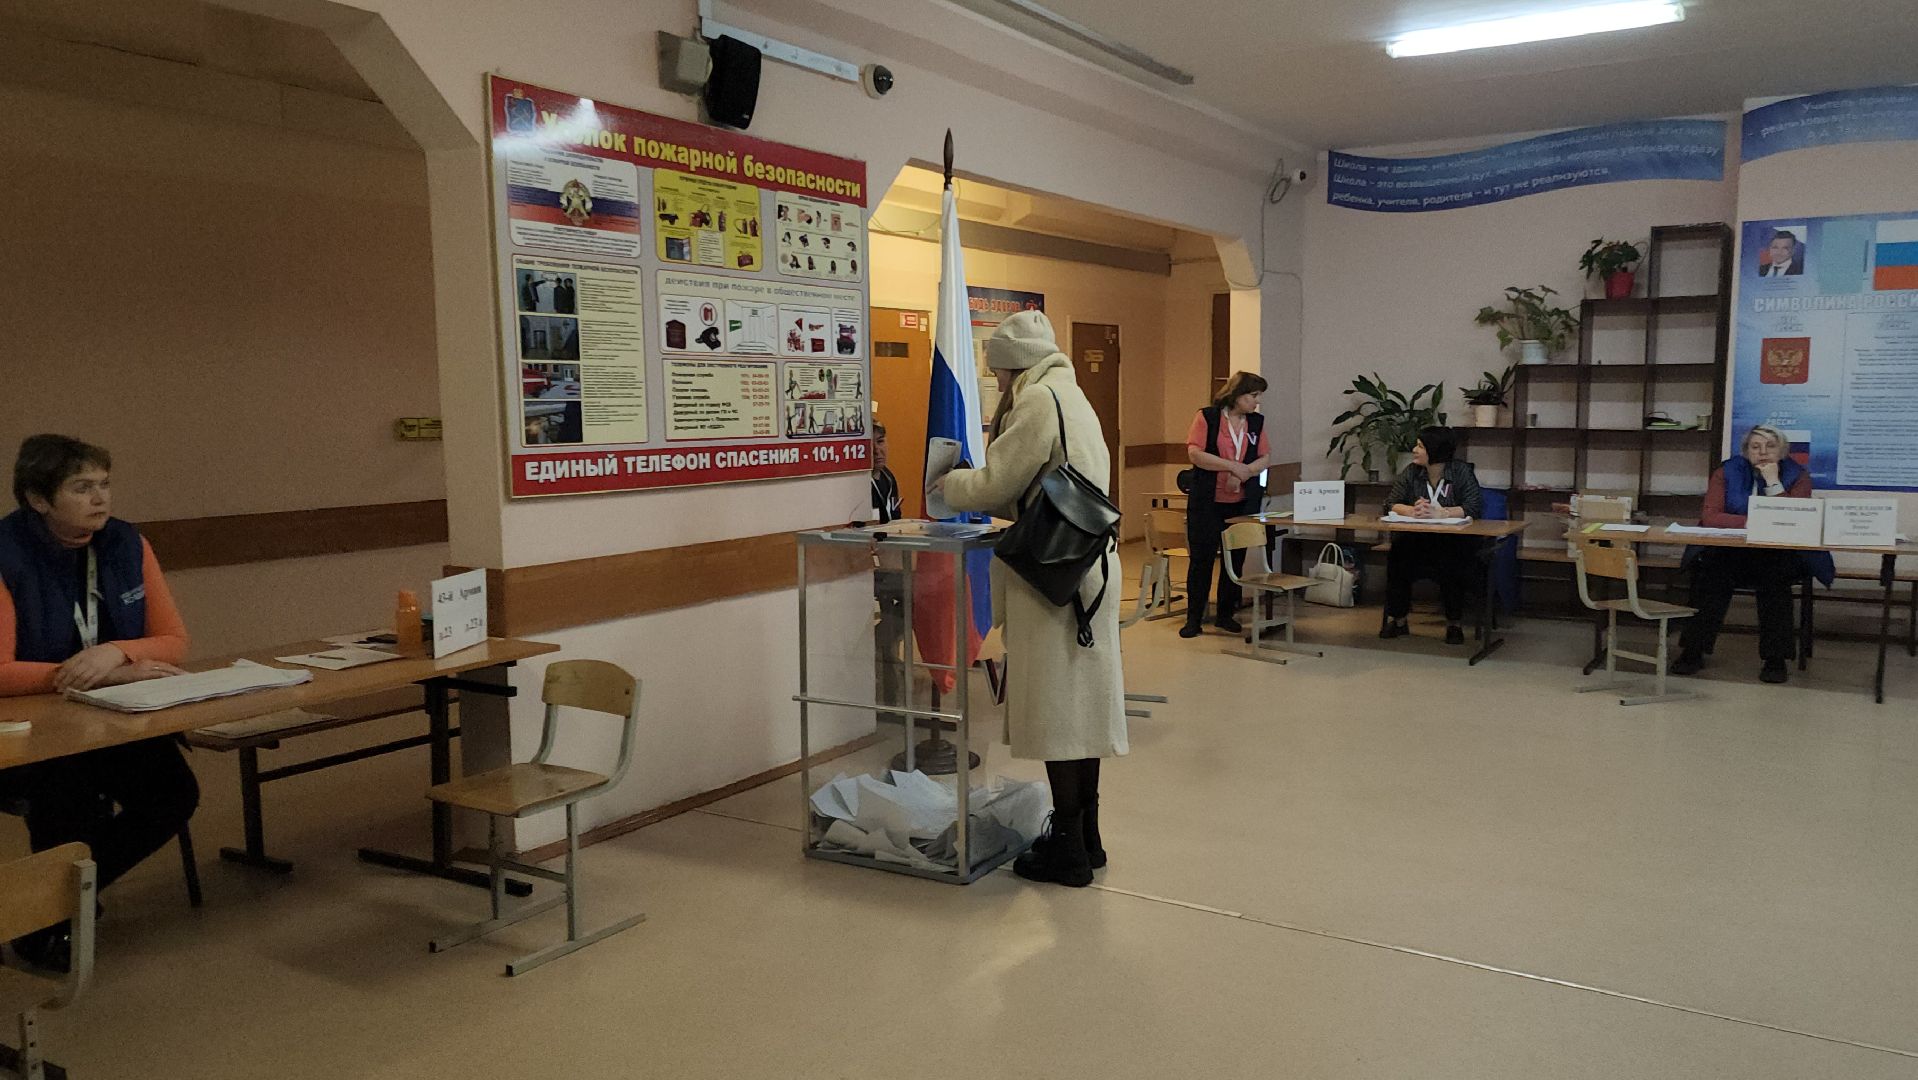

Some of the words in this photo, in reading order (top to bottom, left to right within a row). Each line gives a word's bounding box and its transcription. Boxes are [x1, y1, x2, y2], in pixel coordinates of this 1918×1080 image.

[540, 110, 627, 153] Улок
[634, 136, 738, 174] пожарной
[743, 155, 861, 198] безопасности
[1494, 184, 1510, 197] тут
[711, 281, 729, 293] при
[731, 283, 765, 295] пожаре
[1754, 295, 1858, 312] СИМВОЛИКА
[525, 453, 618, 483] ЕДИНЫЙ
[623, 452, 711, 475] ТЕЛЕФОН
[714, 447, 800, 468] СПАСЕНИЯ
[811, 445, 840, 464] 101,
[843, 444, 866, 460] 112
